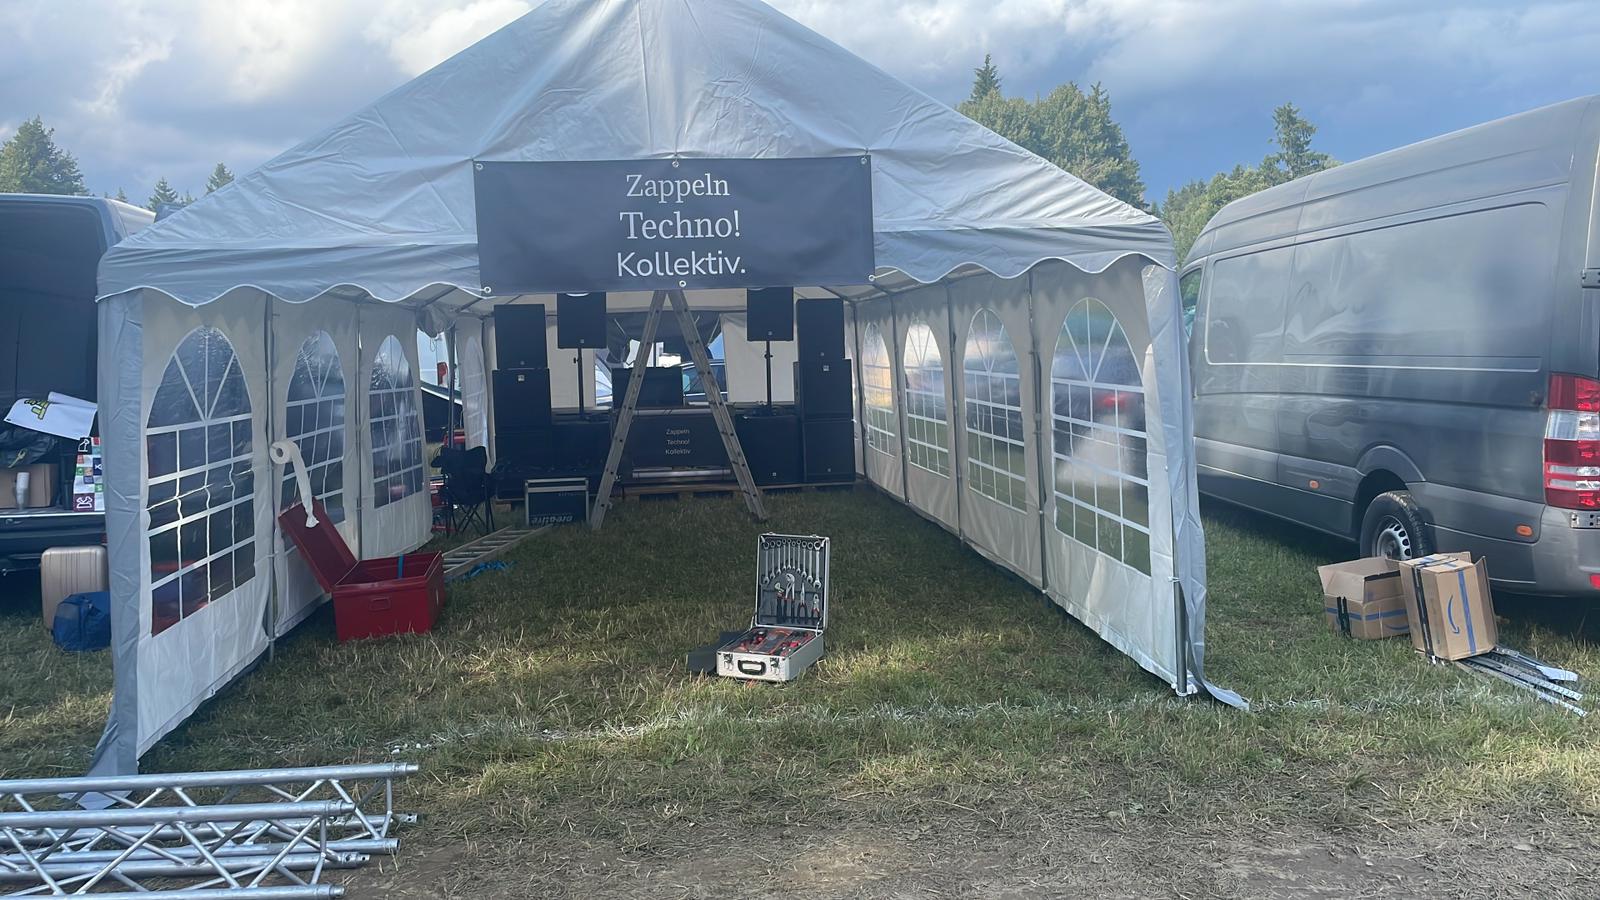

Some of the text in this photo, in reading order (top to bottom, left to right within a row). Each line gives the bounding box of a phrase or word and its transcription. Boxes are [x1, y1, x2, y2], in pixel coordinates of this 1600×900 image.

[626, 172, 731, 204] Zappeln
[619, 209, 740, 240] Techno!
[617, 250, 746, 277] Kollektiv.
